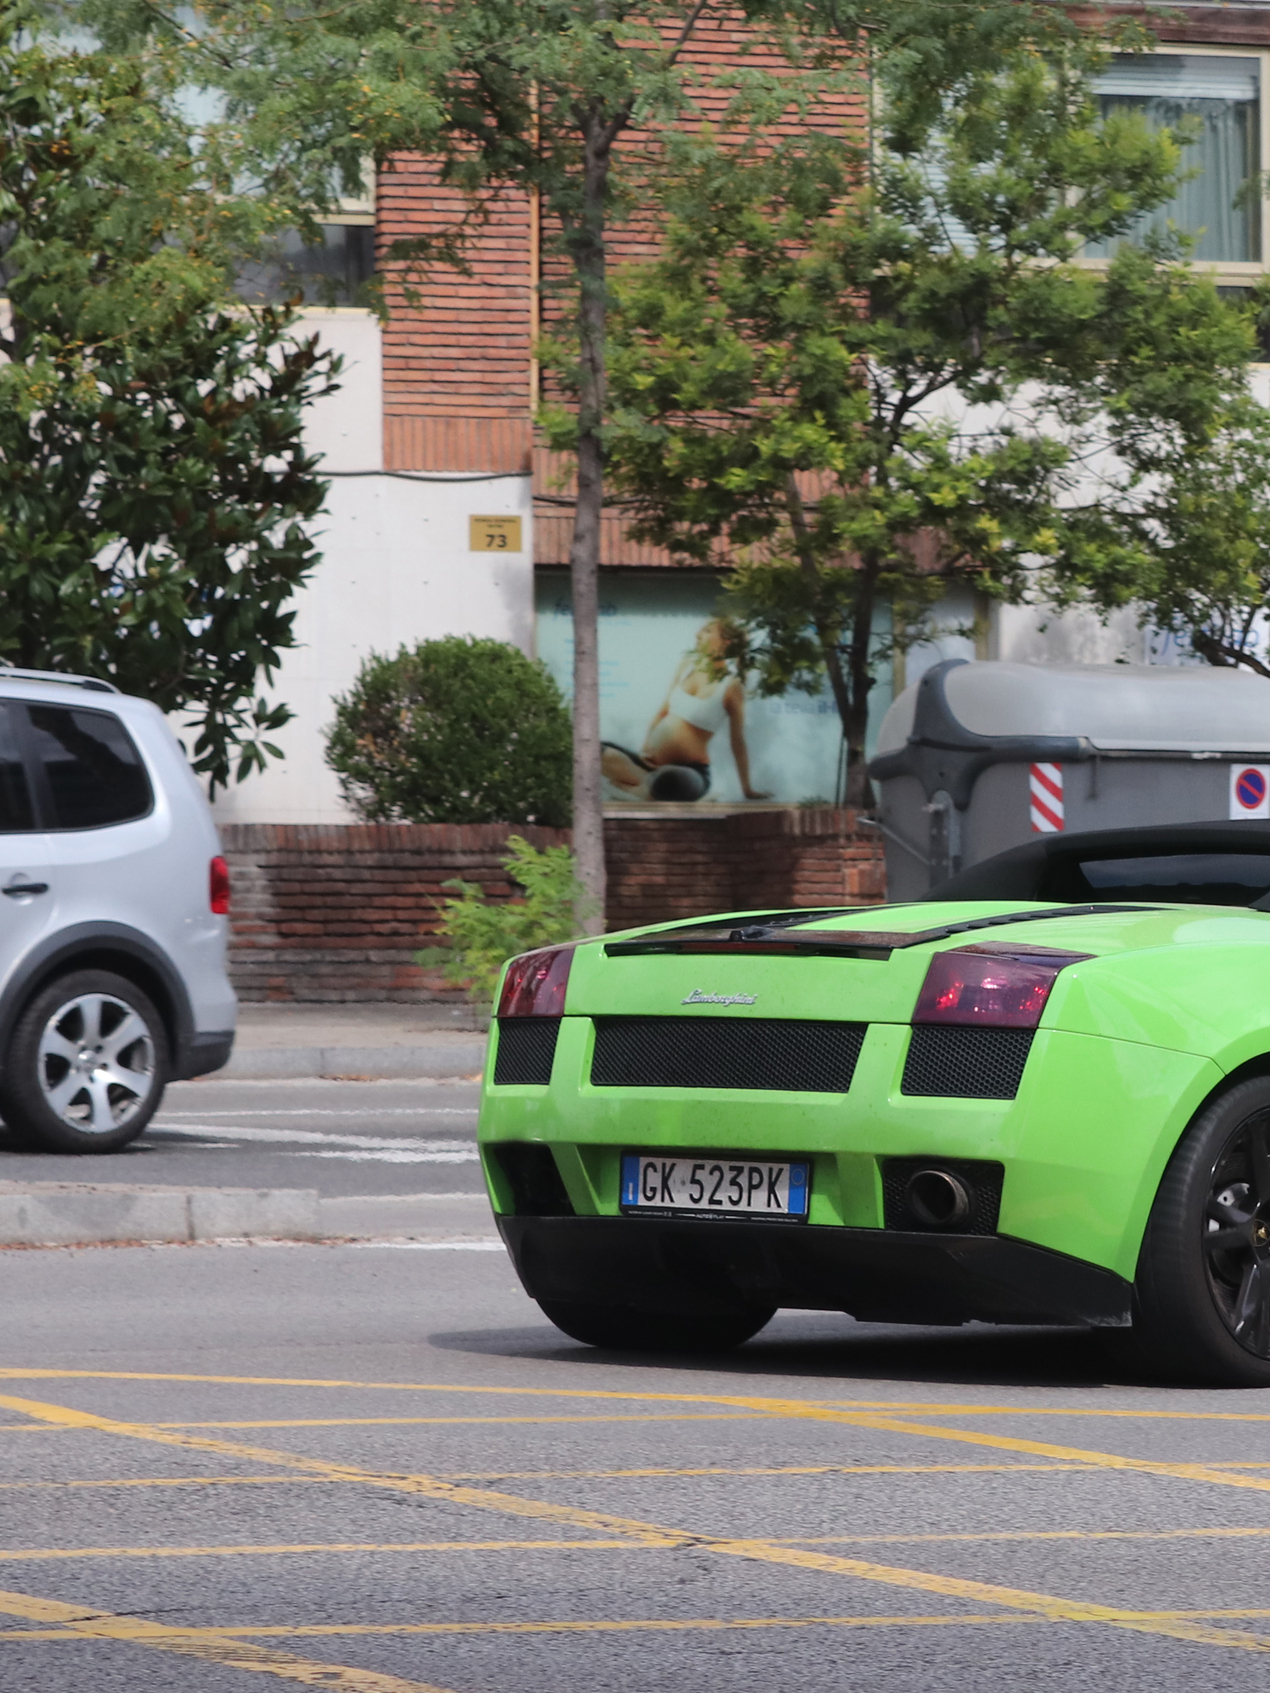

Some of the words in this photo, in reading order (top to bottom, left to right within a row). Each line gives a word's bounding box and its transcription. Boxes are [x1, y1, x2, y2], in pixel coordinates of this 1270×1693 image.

[485, 534, 507, 548] 73
[681, 988, 758, 1007] Lamborghini
[642, 1161, 677, 1203] GK
[688, 1163, 784, 1209] 523PK
